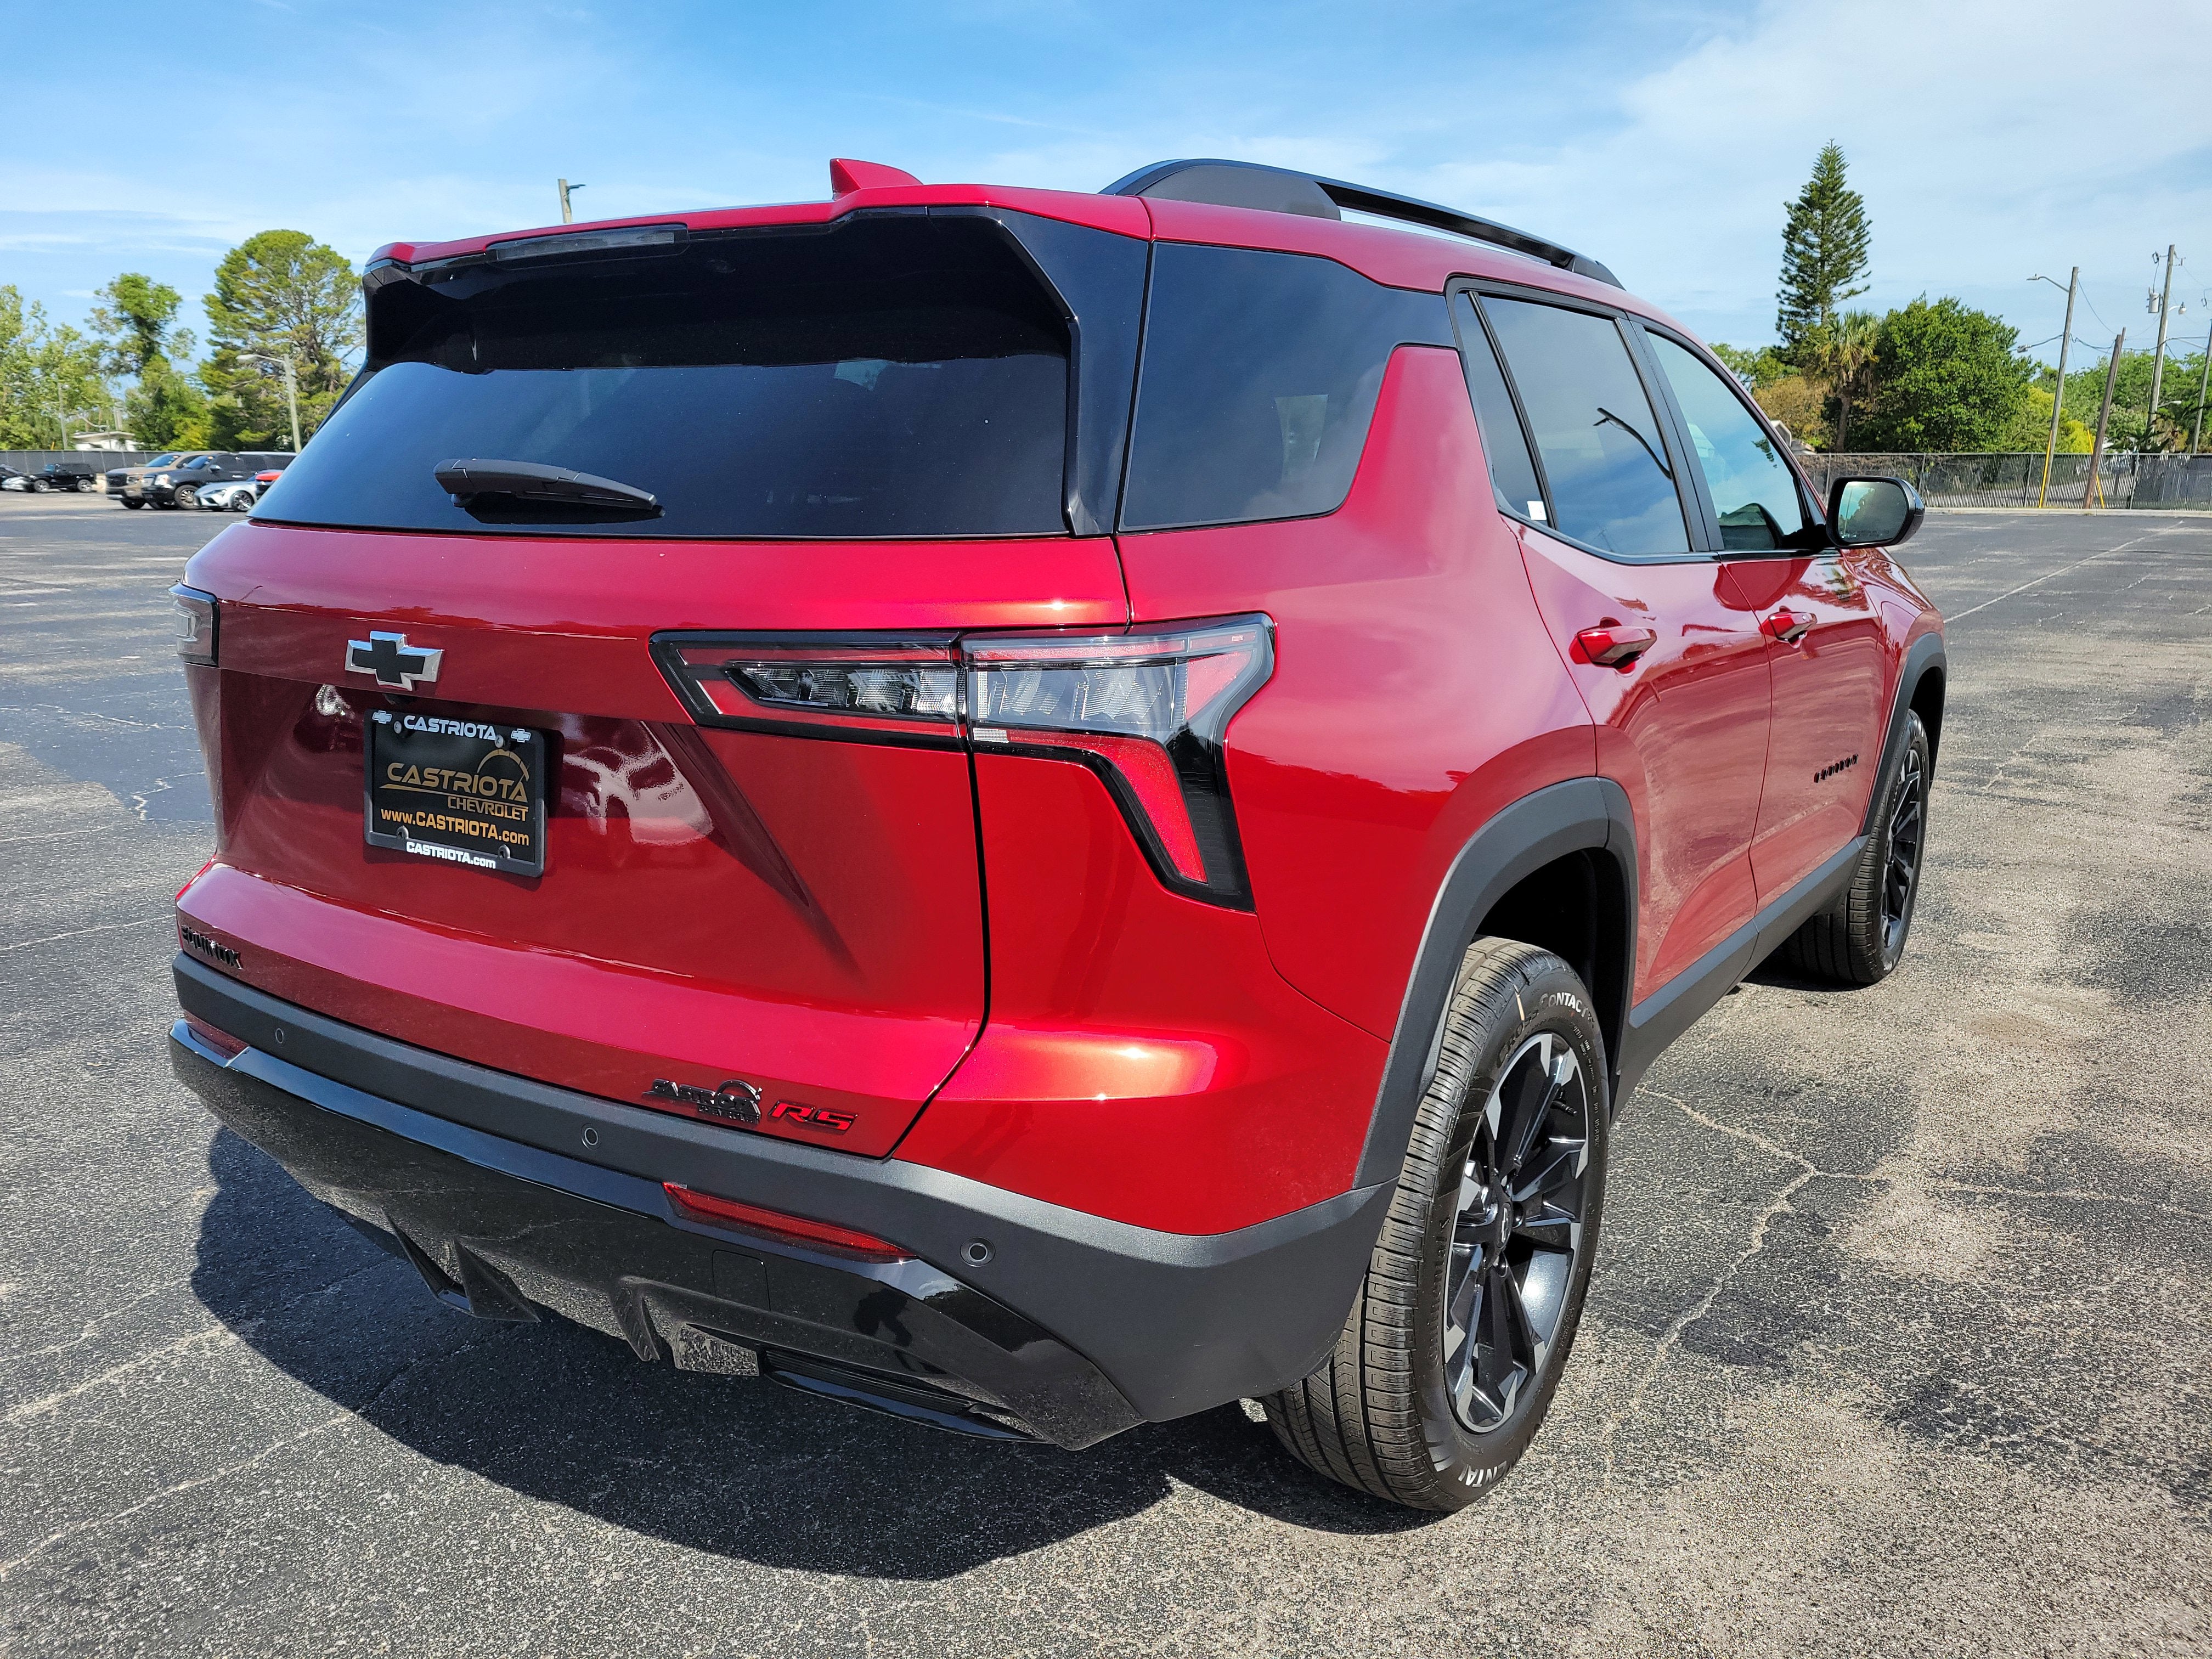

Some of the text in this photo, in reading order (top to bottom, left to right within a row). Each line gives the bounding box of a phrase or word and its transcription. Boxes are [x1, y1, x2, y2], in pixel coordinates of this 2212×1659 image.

[404, 715, 497, 741] CASTRIOTA
[387, 762, 528, 803] CASTRIOTA
[448, 796, 529, 821] CHEVROLET
[381, 809, 529, 846] www.CASTRIOTA.com
[406, 841, 496, 869] CASTRIOTA.com
[768, 1099, 859, 1132] RS
